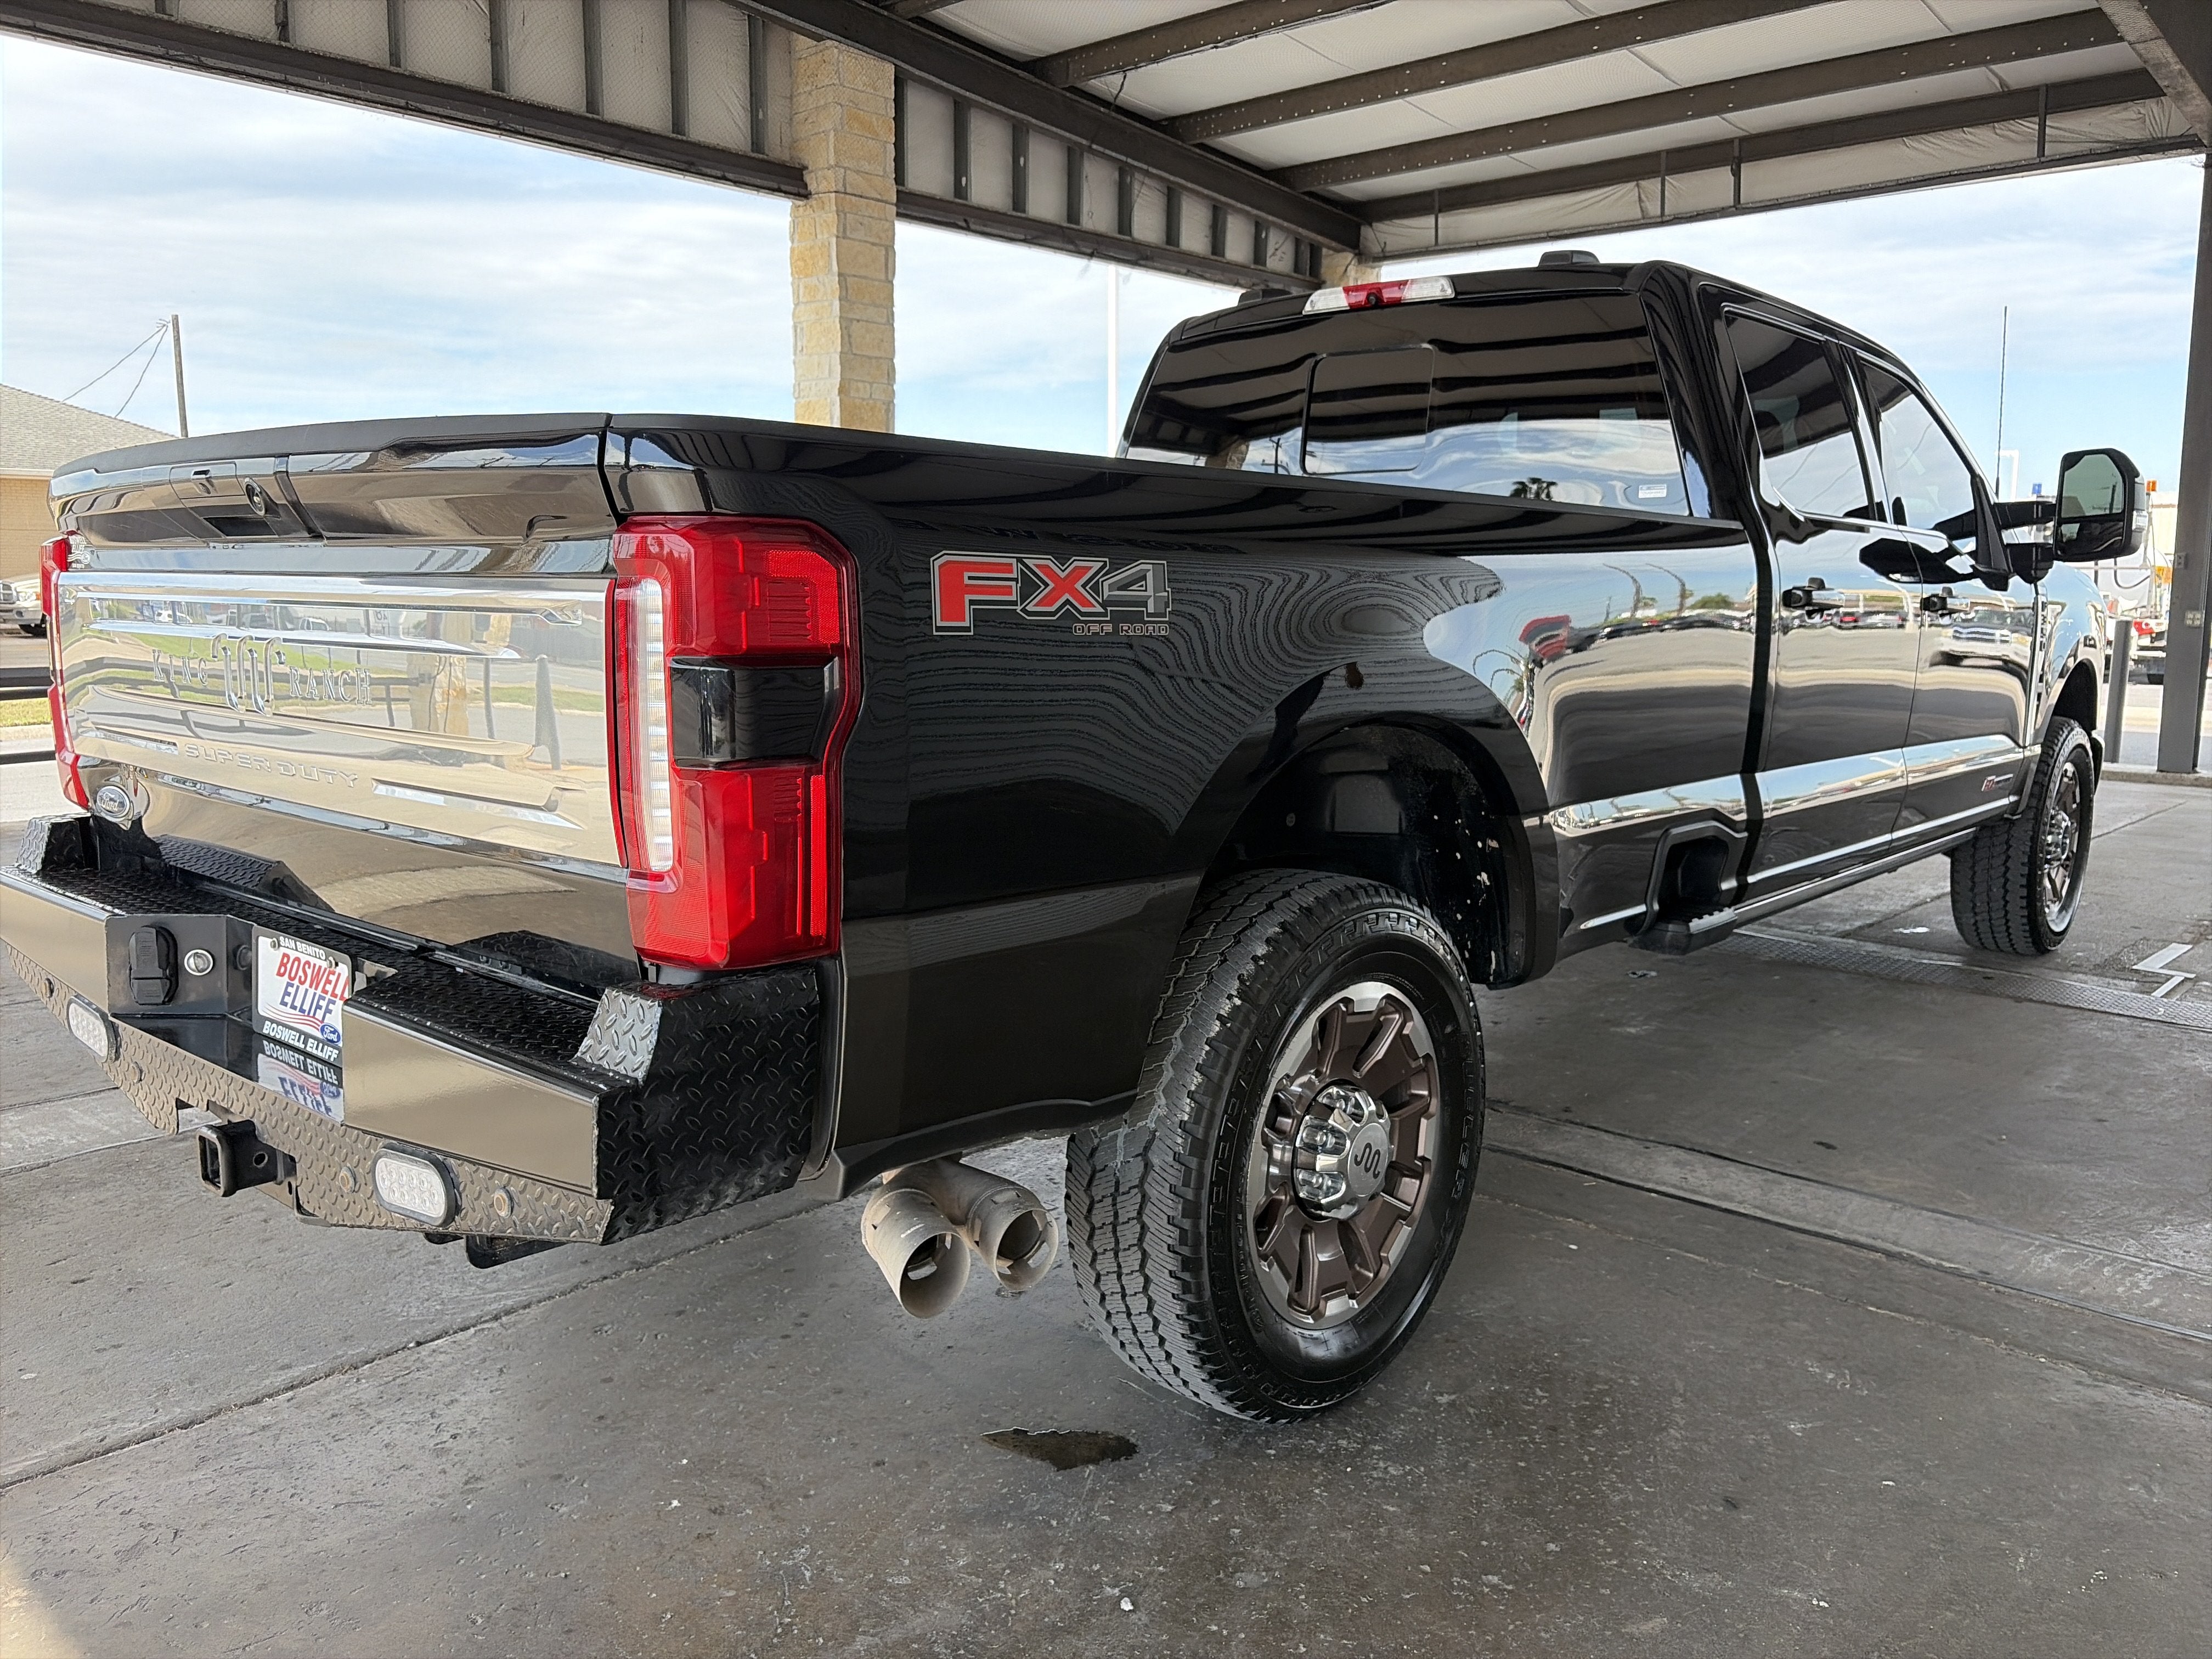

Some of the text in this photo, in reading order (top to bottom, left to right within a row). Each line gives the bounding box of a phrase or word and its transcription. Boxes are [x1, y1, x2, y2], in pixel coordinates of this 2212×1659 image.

[930, 551, 1171, 635] FX4
[1073, 623, 1169, 635] OFF ROAD
[152, 649, 373, 706] KING RANCH
[184, 743, 358, 788] SUPER DUTY
[279, 936, 326, 961] SAN BENITO
[275, 952, 350, 1002] BOSWELL
[279, 981, 336, 1024] ELLIFF
[263, 1020, 339, 1062] BOSWELL ELLIFF
